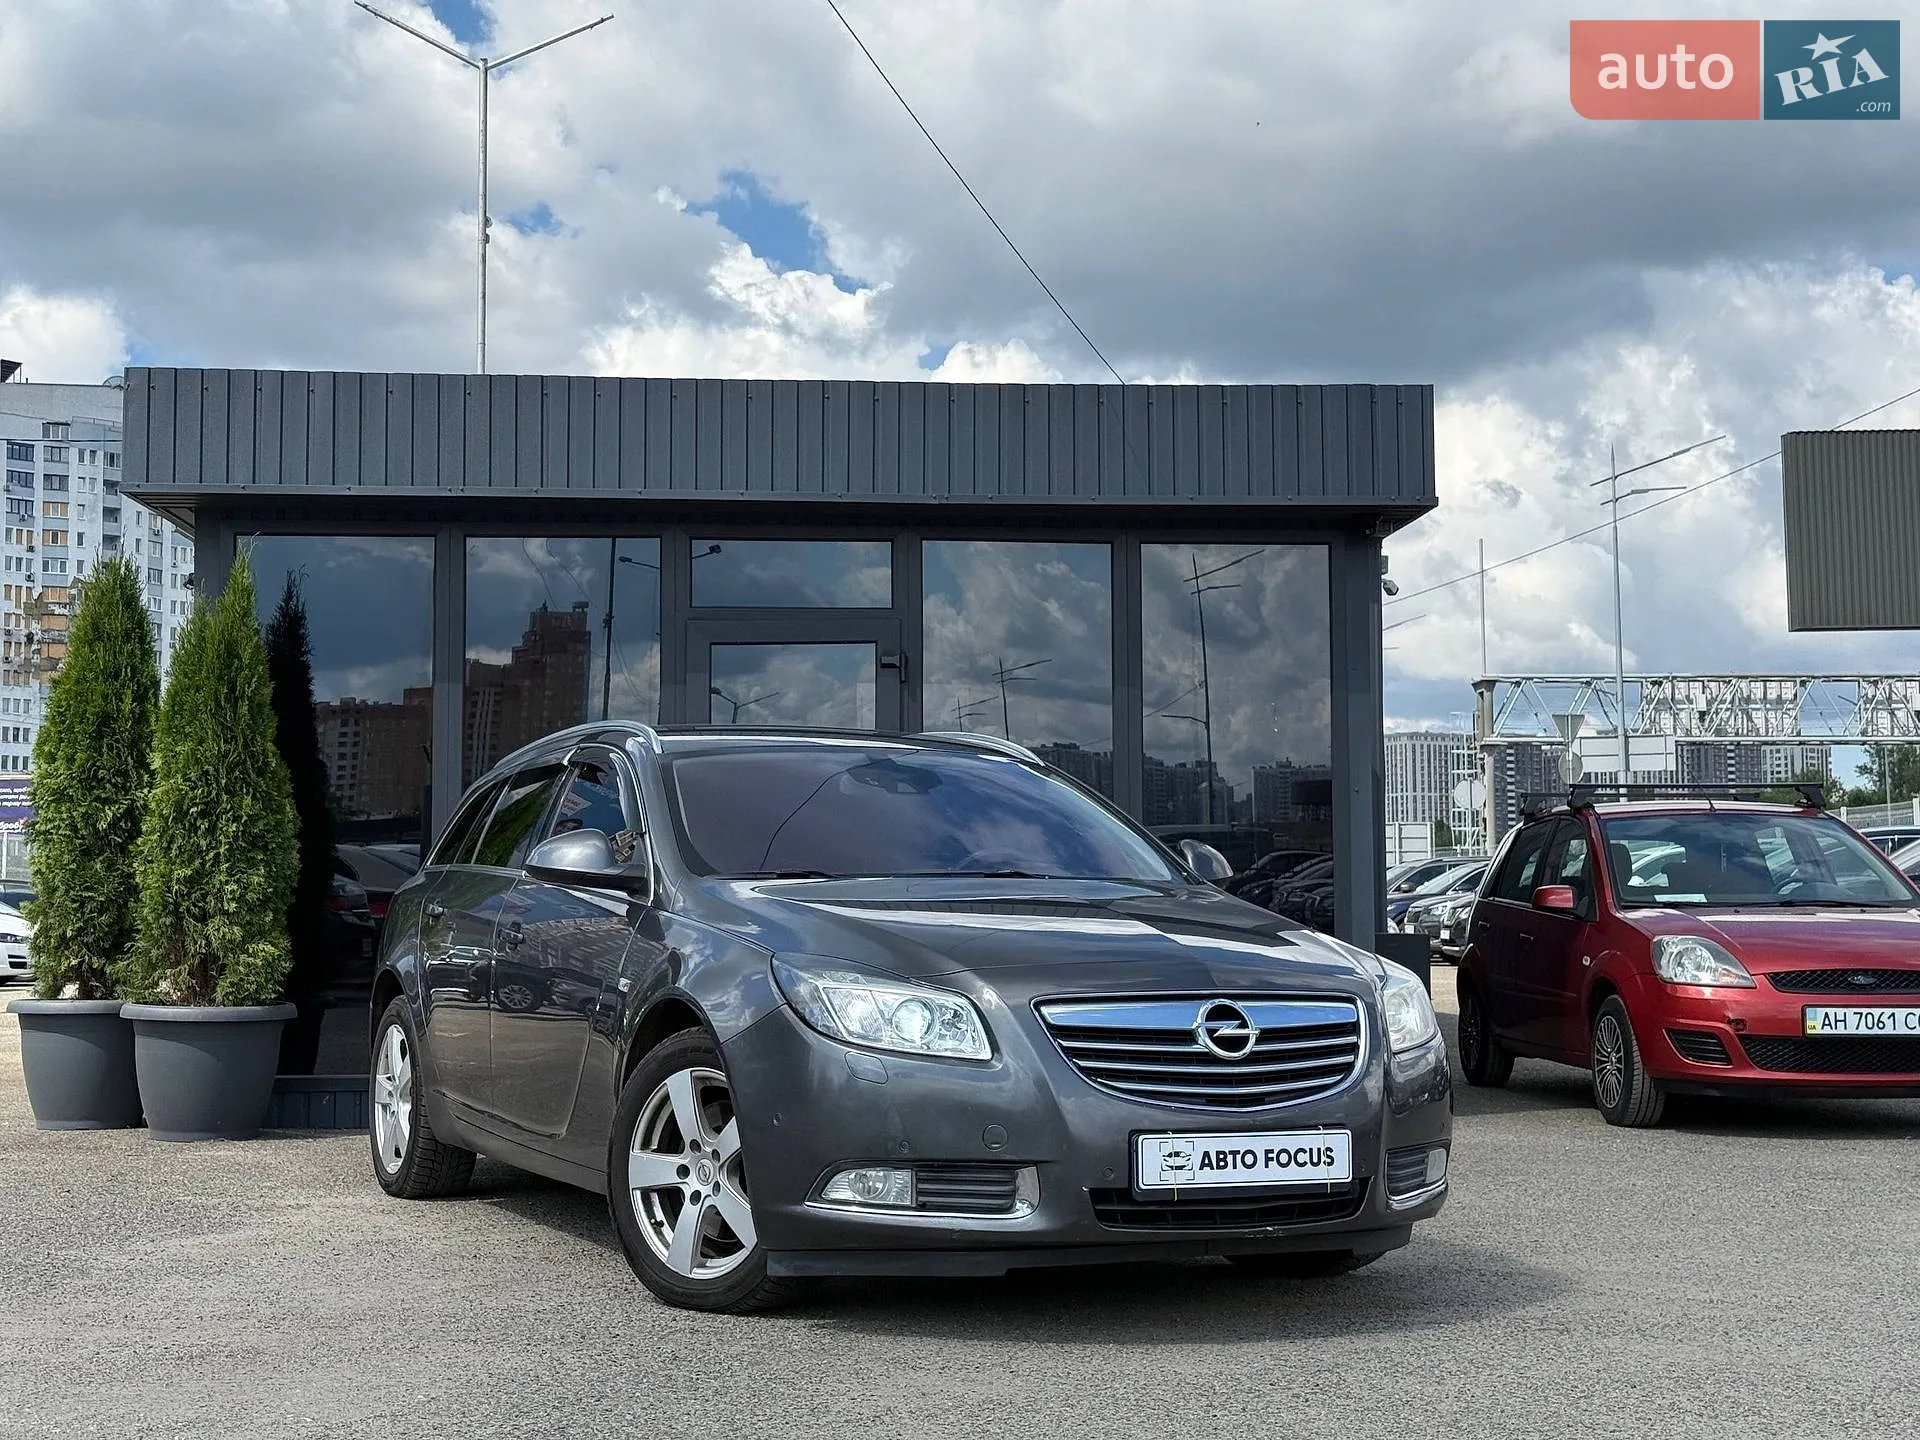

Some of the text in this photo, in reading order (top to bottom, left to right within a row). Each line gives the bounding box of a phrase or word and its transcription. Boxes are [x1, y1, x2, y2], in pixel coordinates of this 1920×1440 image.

[1821, 1011, 1920, 1031] AH 7061 C
[1199, 1146, 1335, 1171] АВТО FOCUS
